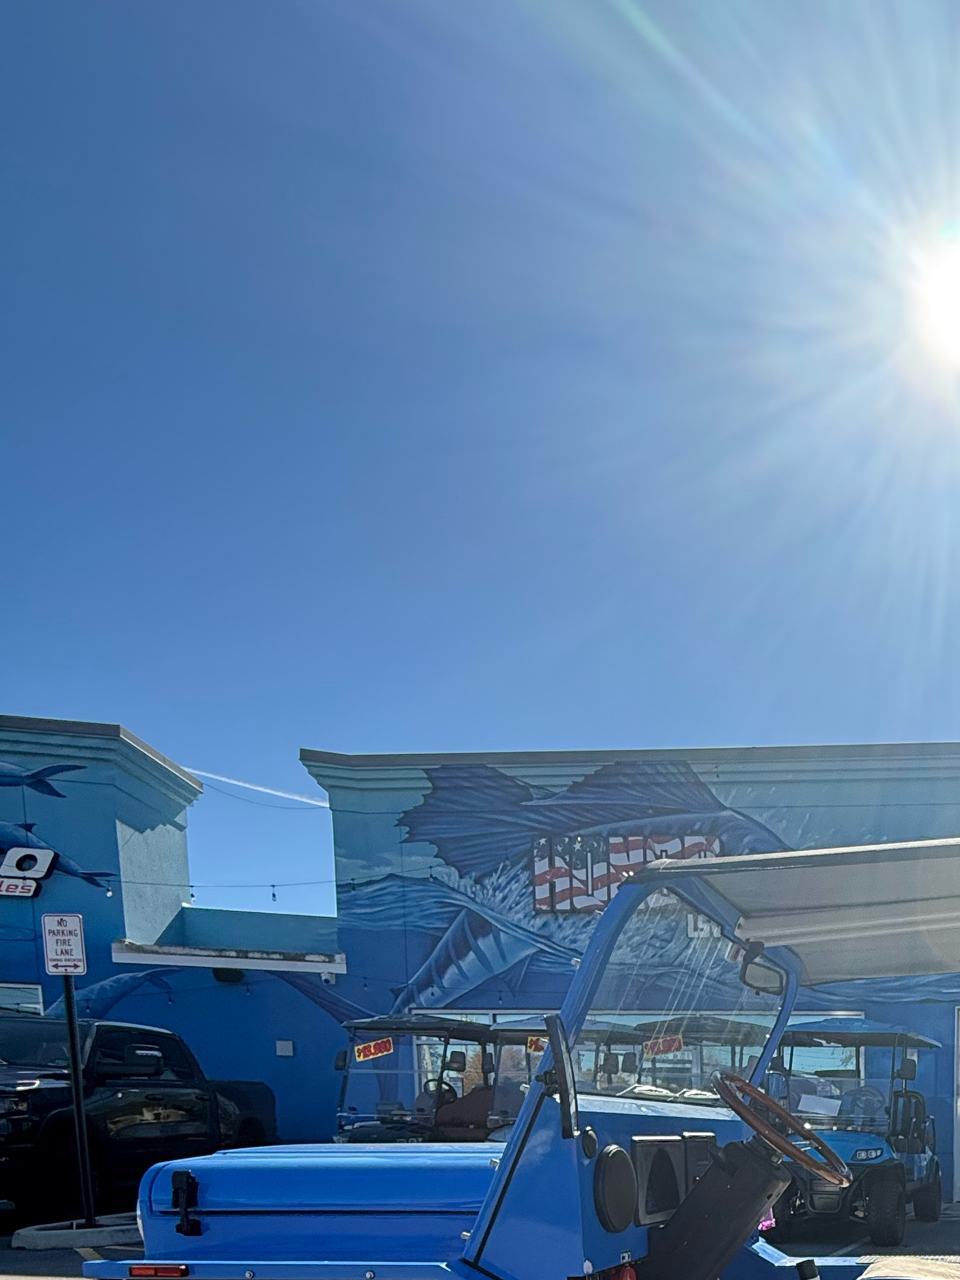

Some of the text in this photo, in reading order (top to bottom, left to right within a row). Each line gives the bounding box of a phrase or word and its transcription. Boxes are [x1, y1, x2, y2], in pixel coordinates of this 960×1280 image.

[56, 919, 68, 928] NO
[47, 928, 79, 938] PARKING
[55, 938, 72, 947] FIRE
[54, 947, 74, 957] LANE
